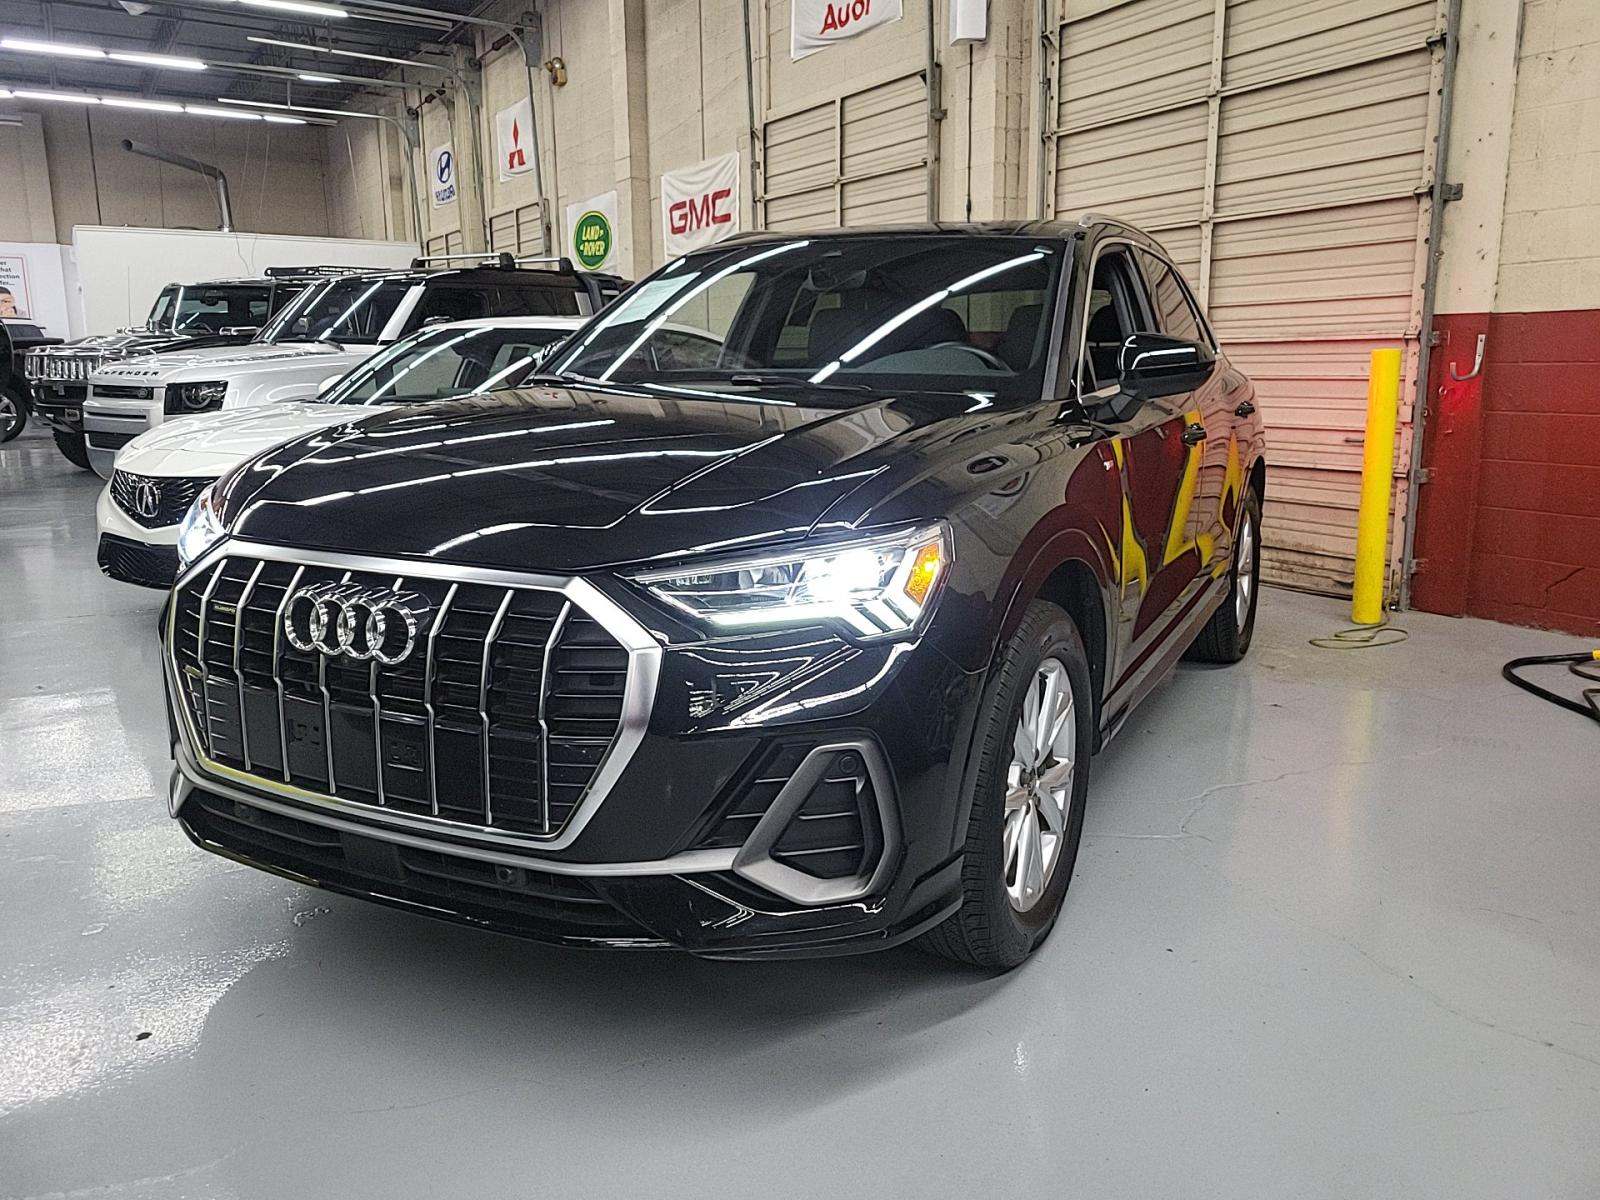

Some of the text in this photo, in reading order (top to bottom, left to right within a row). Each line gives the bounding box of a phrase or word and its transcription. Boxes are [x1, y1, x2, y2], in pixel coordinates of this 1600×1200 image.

[669, 188, 732, 235] GMC
[582, 225, 601, 241] LAND
[583, 240, 606, 256] ROVER
